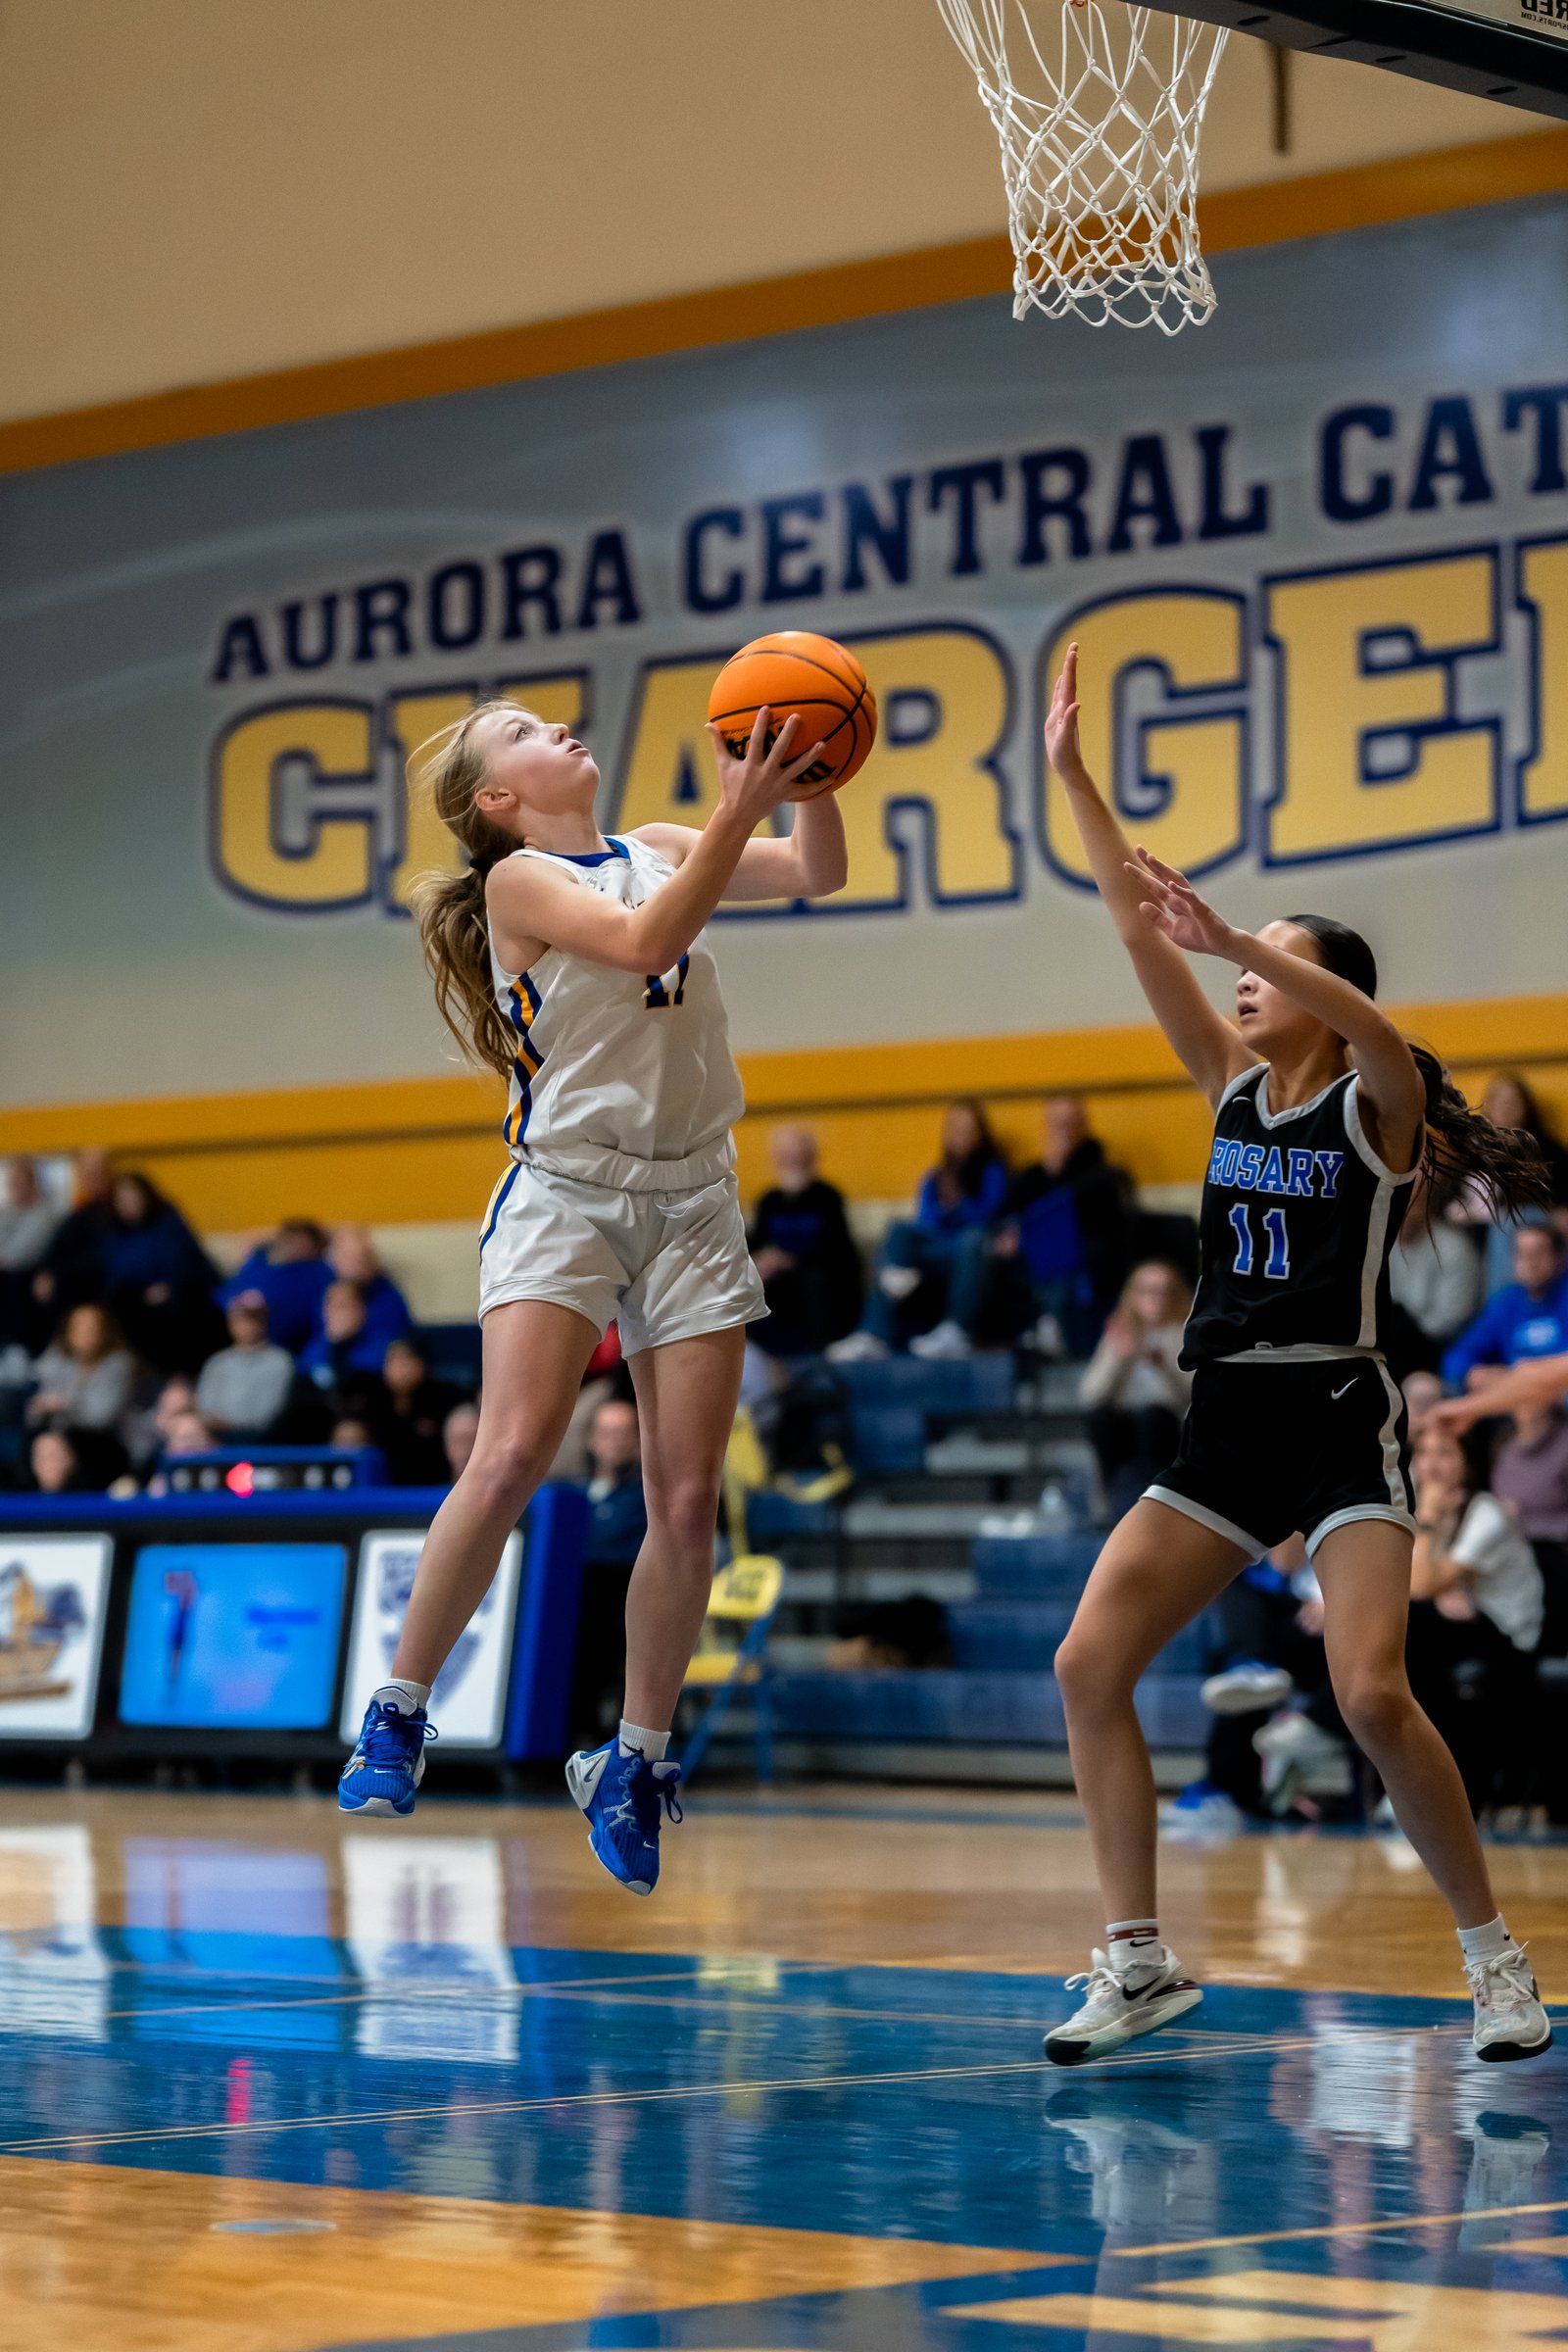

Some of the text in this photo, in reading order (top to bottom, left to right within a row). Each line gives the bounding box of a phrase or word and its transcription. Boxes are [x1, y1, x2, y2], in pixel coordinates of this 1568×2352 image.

[210, 386, 1568, 684] AURORA CENTRAL CAT
[207, 530, 1568, 919] CARGE
[1208, 1137, 1345, 1198] ROSARY
[1228, 1202, 1290, 1280] 11
